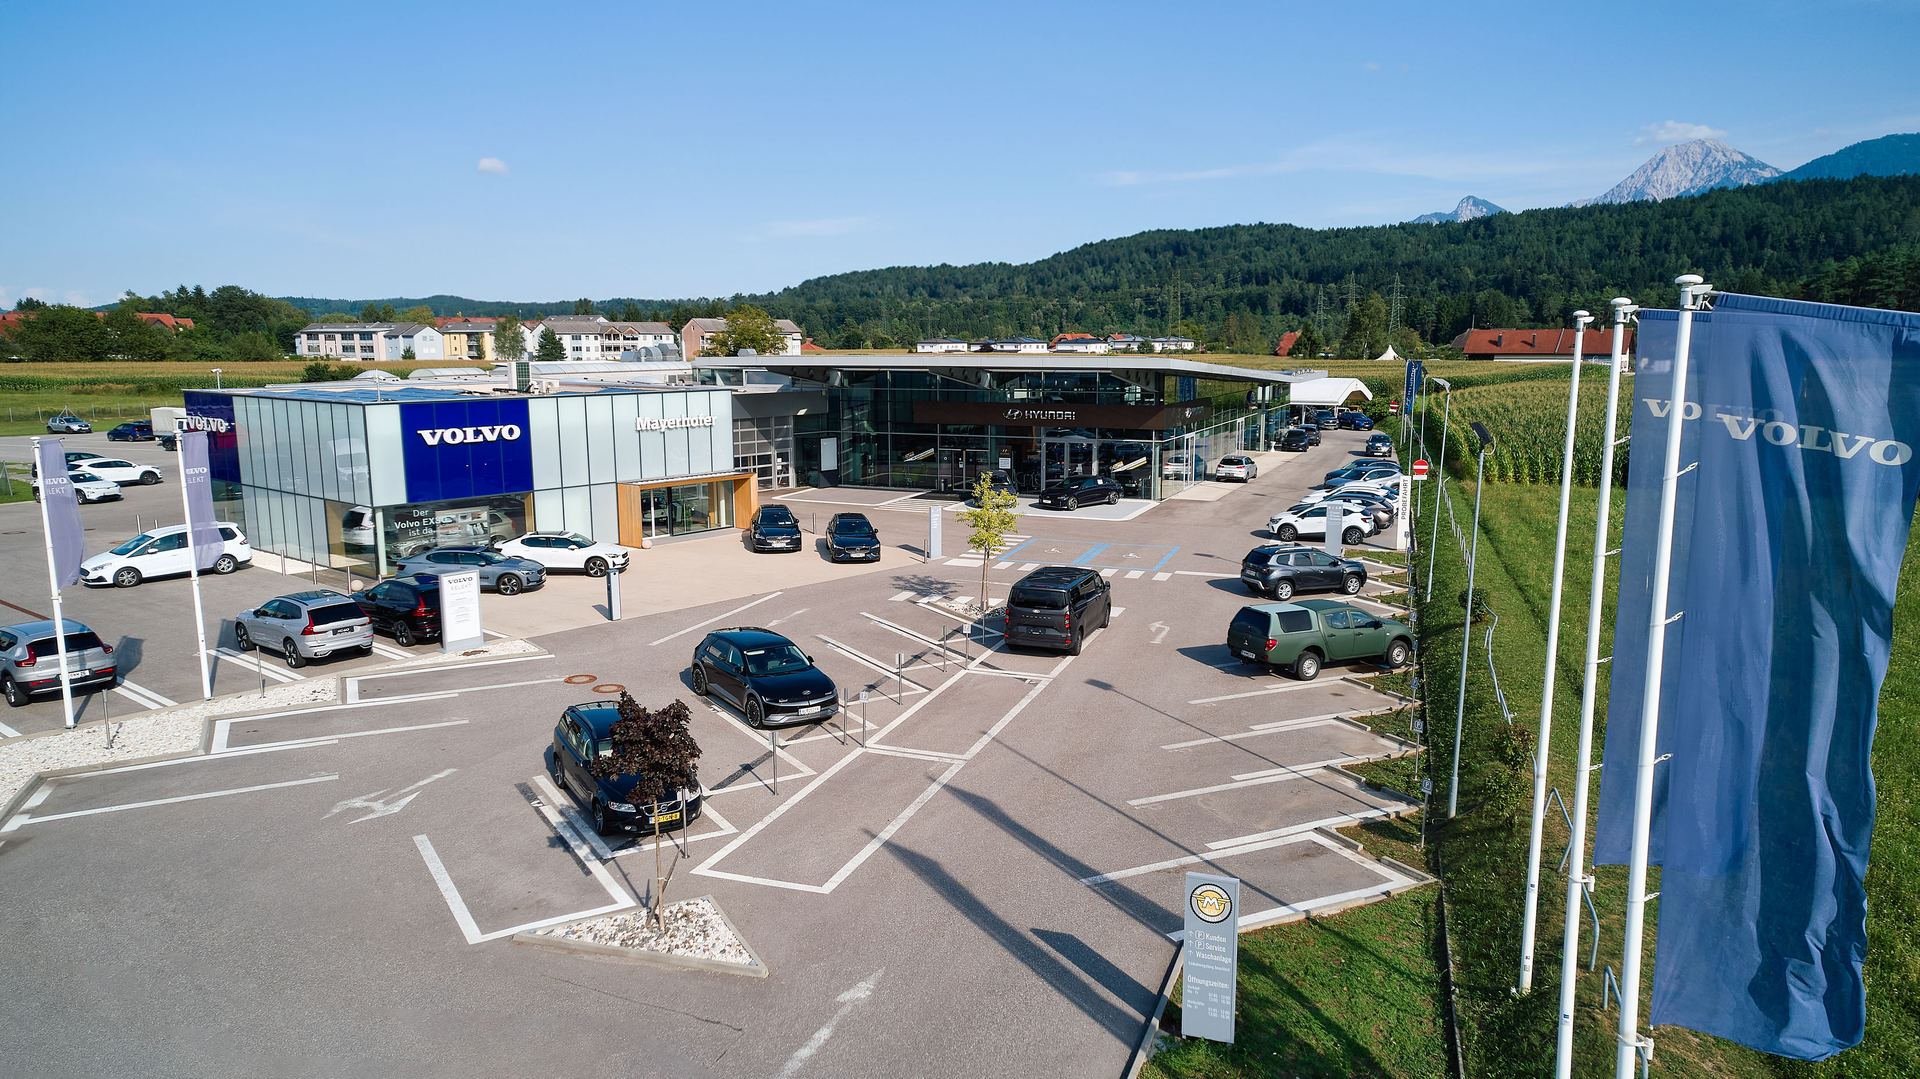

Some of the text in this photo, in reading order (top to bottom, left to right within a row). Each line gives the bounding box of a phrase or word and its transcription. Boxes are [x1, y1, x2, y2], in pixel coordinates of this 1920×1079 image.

[1025, 410, 1076, 421] HYUNDAI
[636, 414, 717, 433] Mayerhofer
[417, 424, 521, 446] VOLVO
[1716, 413, 1913, 466] VOLVO
[1401, 479, 1409, 520] PROBEFAHRT
[412, 509, 429, 518] Der
[394, 520, 420, 530] Volvo
[409, 526, 436, 537] ist da.
[447, 576, 474, 585] VOLVO
[1205, 933, 1227, 943] Kunden
[1205, 942, 1226, 953] Service
[1195, 950, 1232, 964] Waschanlage
